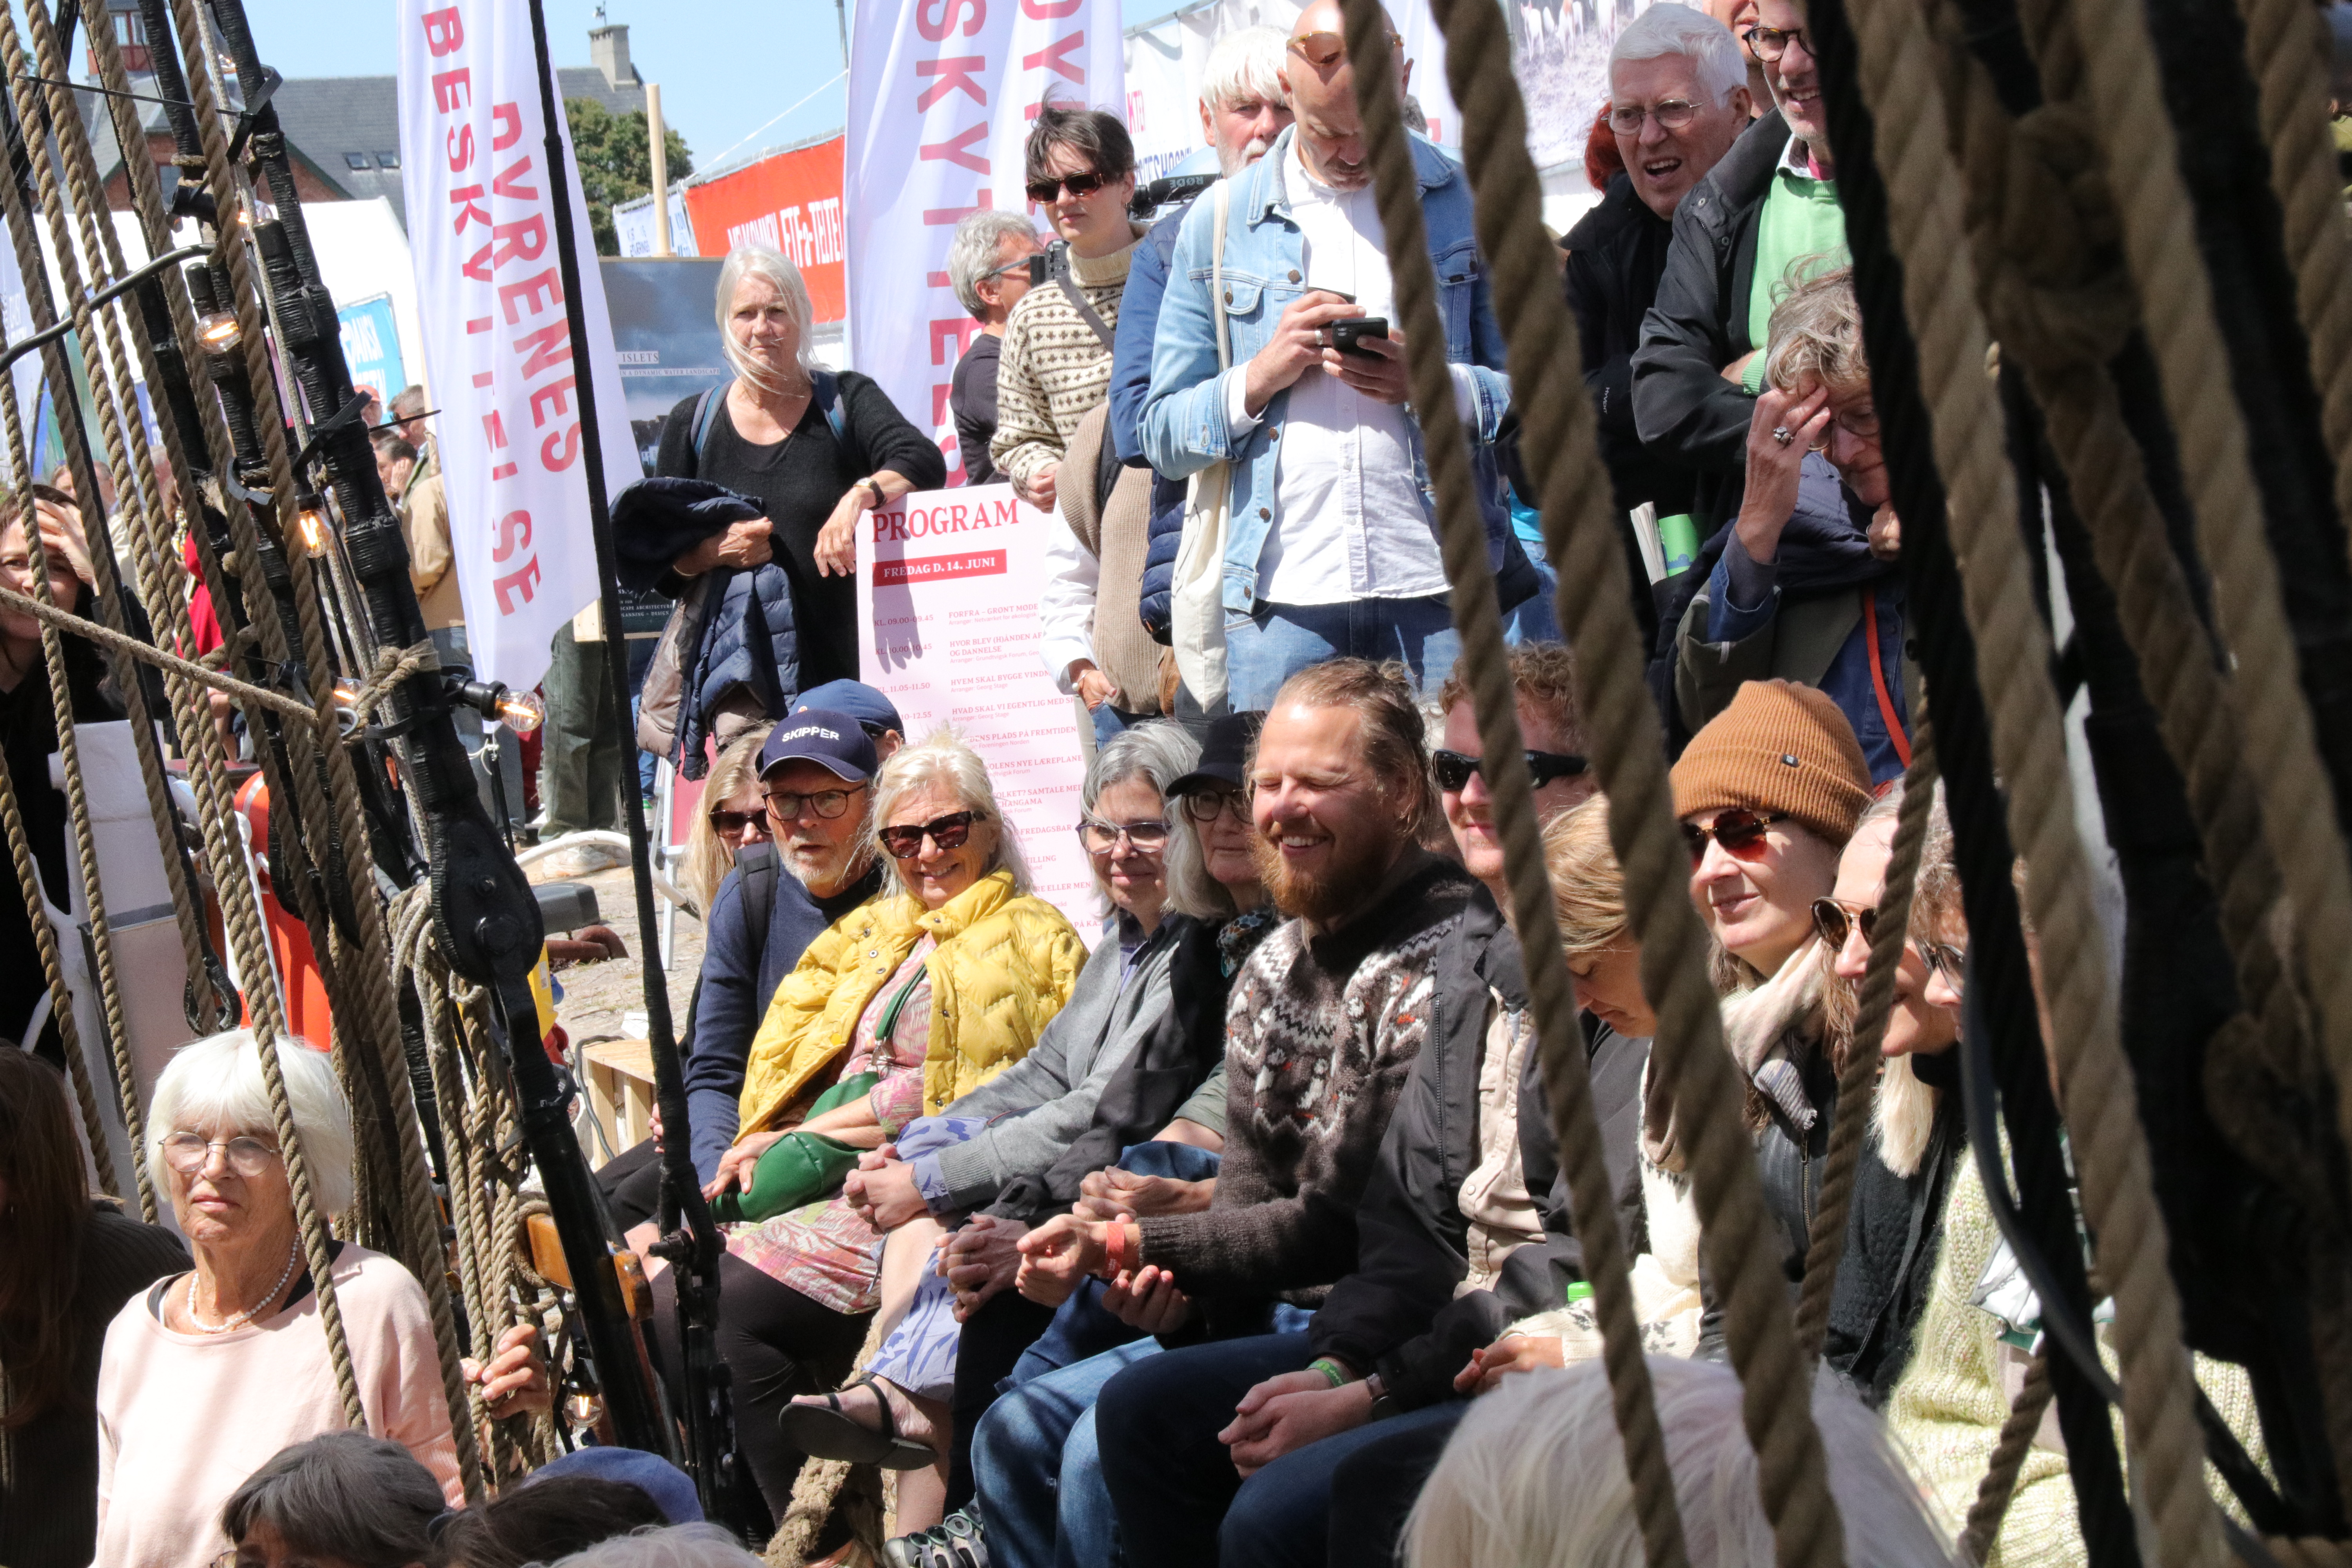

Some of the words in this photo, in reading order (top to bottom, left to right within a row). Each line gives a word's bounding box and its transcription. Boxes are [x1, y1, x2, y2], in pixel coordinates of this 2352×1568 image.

[623, 353, 659, 363] ISLETS
[871, 498, 1019, 543] PROGRAM
[884, 564, 931, 577] FREDAG
[933, 561, 944, 573] D.
[947, 560, 963, 572] 14.
[965, 557, 995, 569] JUNI
[949, 610, 979, 618] FORFRA
[887, 615, 933, 625] 09.00-09.45
[993, 633, 1030, 644] (H)ÅNDEN
[889, 644, 932, 653] 10.00-10.45
[962, 646, 1002, 655] DANNELSE
[976, 653, 1008, 661] Grundtvigsk
[998, 673, 1022, 681] BYGGE
[890, 682, 930, 692] 11.05-11.50
[1007, 700, 1045, 709] EGENTLIG
[782, 726, 840, 742] SKIPPER
[992, 731, 1017, 740] PLADS
[1019, 729, 1029, 738] PÅ
[1031, 726, 1078, 736] FREMTIDEN
[1028, 786, 1064, 795] SAMTALE
[1020, 824, 1072, 835] FREDAGSBAR
[1047, 883, 1071, 891] ELLER
[1074, 920, 1084, 928] PÅ
